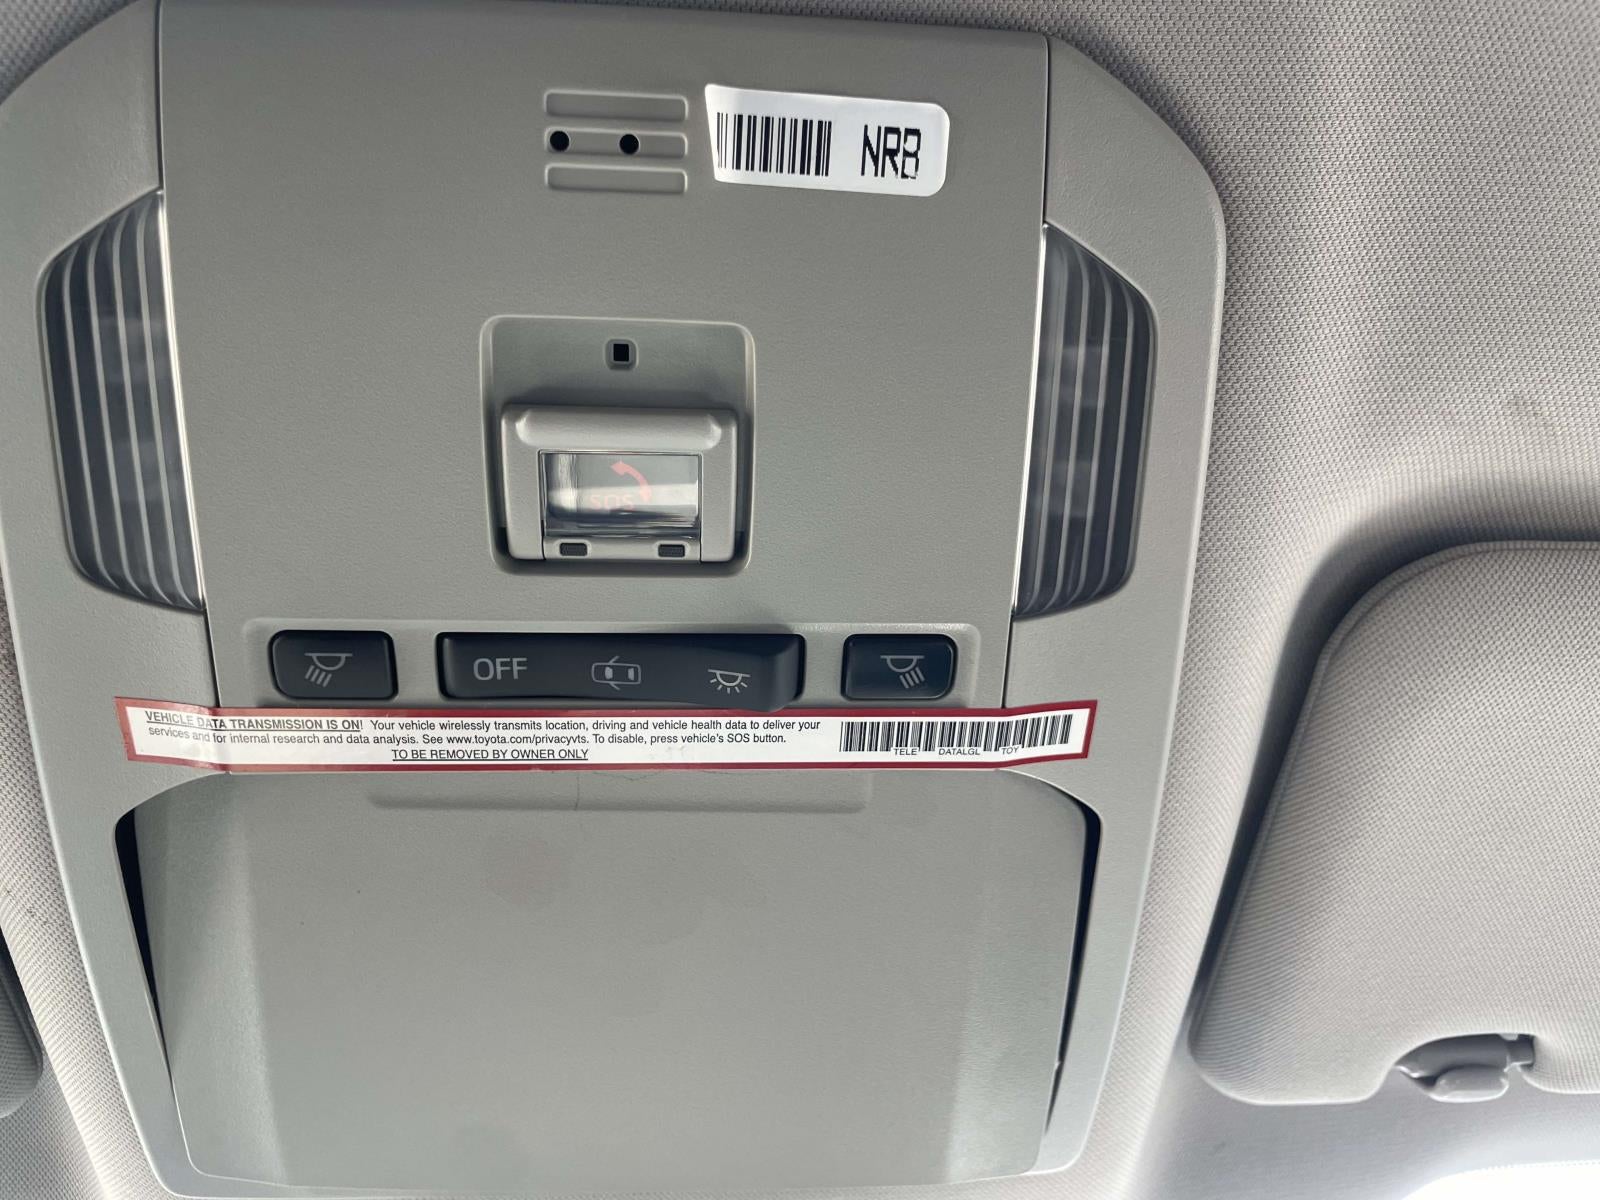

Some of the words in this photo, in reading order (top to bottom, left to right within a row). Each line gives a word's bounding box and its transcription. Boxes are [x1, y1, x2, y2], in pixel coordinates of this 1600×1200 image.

[590, 494, 634, 511] SOS
[472, 657, 527, 680] OFF
[145, 710, 194, 726] VEHICLE
[197, 717, 227, 730] DATA
[230, 719, 323, 730] TRANSMISSION
[326, 719, 338, 730] IS
[342, 719, 363, 731] ON!
[371, 719, 396, 731] Your
[399, 719, 436, 731] vehicle
[439, 719, 491, 733] wirelessly
[494, 719, 542, 731] transmits
[545, 719, 588, 732] location,
[592, 719, 627, 733] driving
[630, 719, 649, 731] and
[652, 719, 687, 731] vehicle
[691, 719, 722, 731] health
[725, 719, 747, 731] data
[750, 720, 760, 731] to
[763, 719, 794, 731] deliver
[797, 721, 821, 733] your
[148, 726, 190, 740] services
[192, 731, 210, 743] and
[213, 733, 227, 744] for
[230, 733, 270, 744] internal
[273, 733, 320, 744] research
[323, 733, 343, 744] and
[346, 733, 370, 744] data
[373, 733, 419, 746] analysis.
[422, 733, 443, 744] See
[446, 733, 589, 746] www.toyota.com/privacyvts.
[592, 733, 606, 744] To
[608, 733, 647, 746] disable,
[650, 735, 678, 746] press
[681, 732, 724, 744] vehicle's
[727, 732, 750, 744] SOS
[753, 732, 787, 744] button.
[393, 749, 409, 760] TO
[412, 749, 427, 760] BE
[430, 749, 489, 760] REMOVED
[492, 749, 508, 760] BY
[511, 749, 555, 760] OWNER
[558, 749, 589, 760] ONLY
[893, 747, 918, 756] TELE
[938, 747, 981, 756] DATALGL
[1001, 746, 1020, 755] TOY
